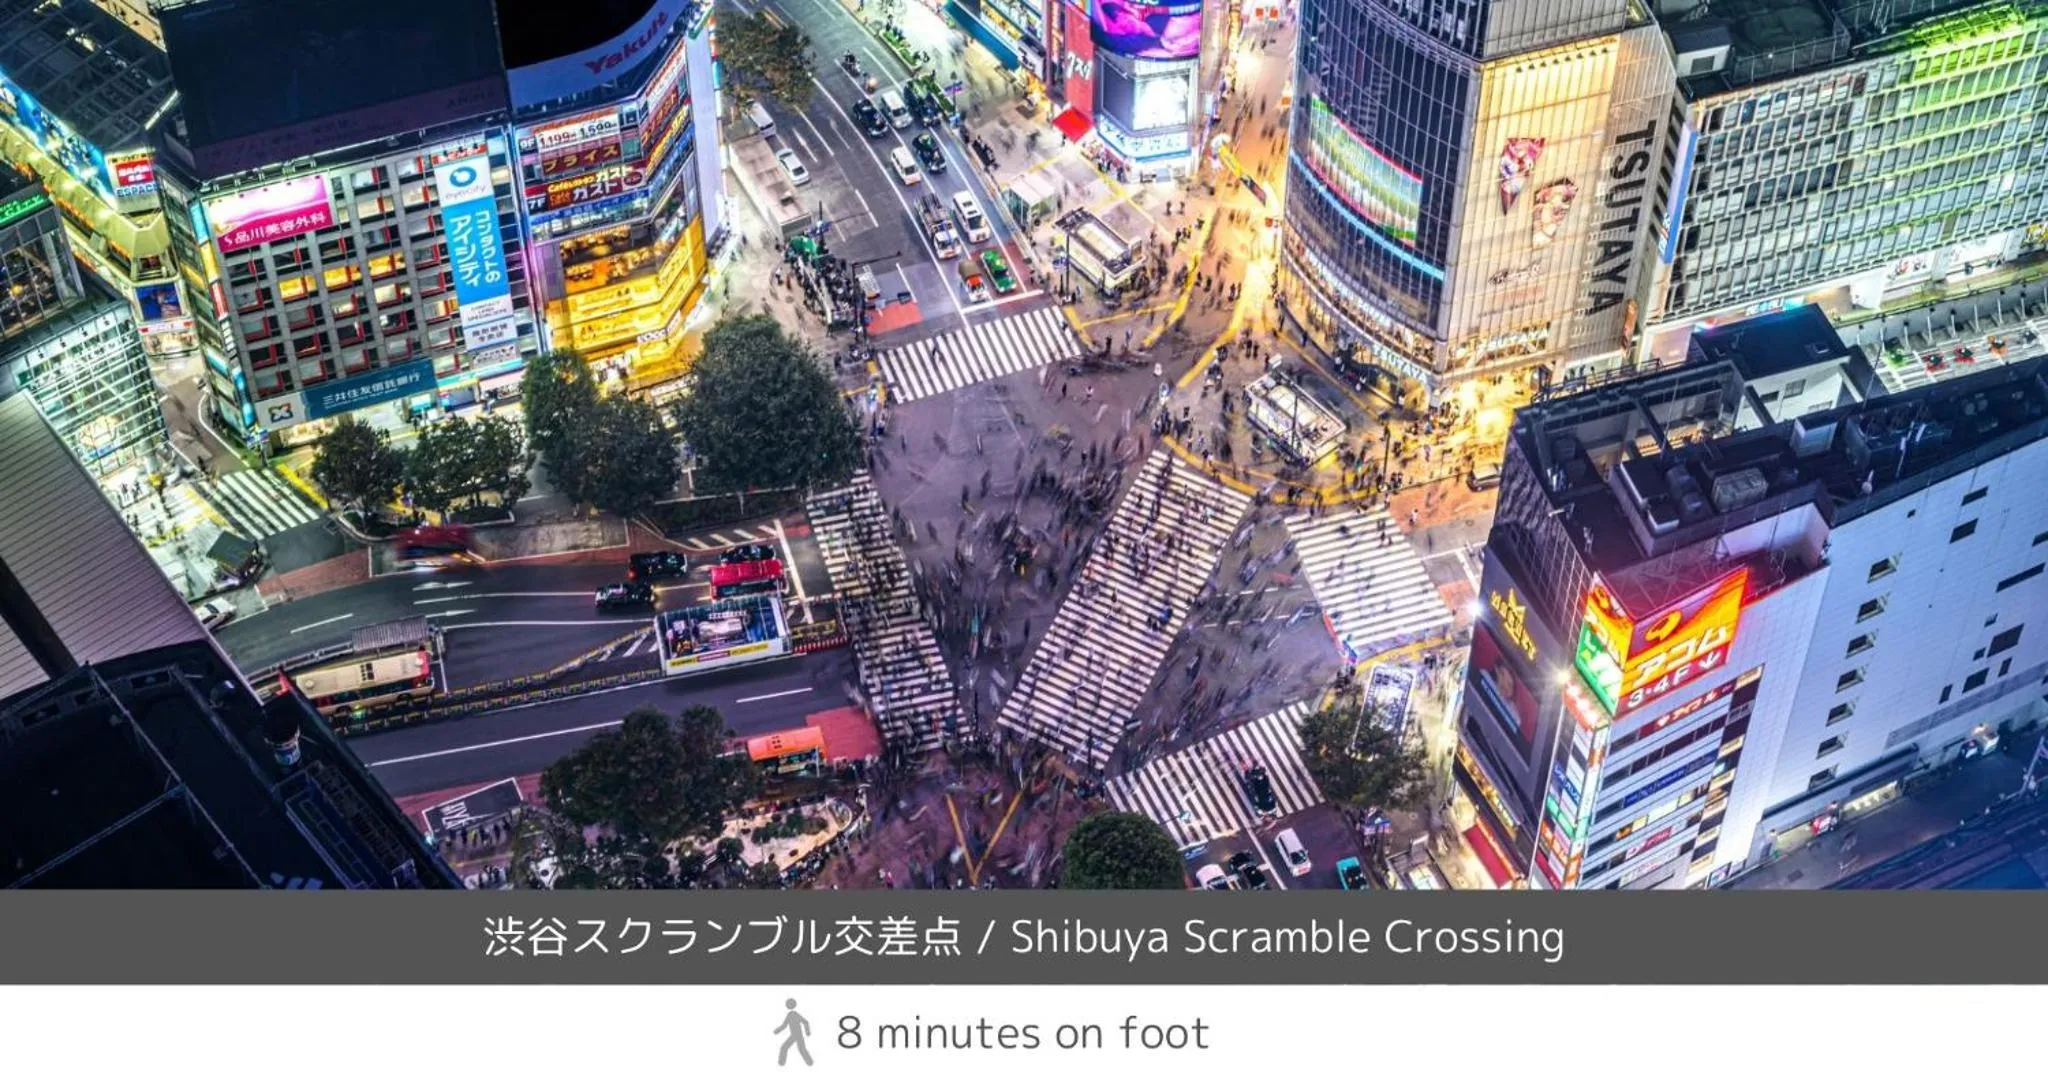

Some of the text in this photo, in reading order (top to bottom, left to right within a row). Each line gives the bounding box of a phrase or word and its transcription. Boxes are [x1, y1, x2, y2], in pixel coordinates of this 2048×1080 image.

[585, 11, 669, 75] Yakult
[527, 197, 546, 210] 7F
[572, 179, 618, 201] ガスト
[1584, 120, 1657, 316] TSUTAYA
[235, 211, 326, 245] 品川美容外科
[449, 214, 482, 287] アイシティ
[475, 210, 502, 284] コンタクトの
[1630, 626, 1728, 690] アコム
